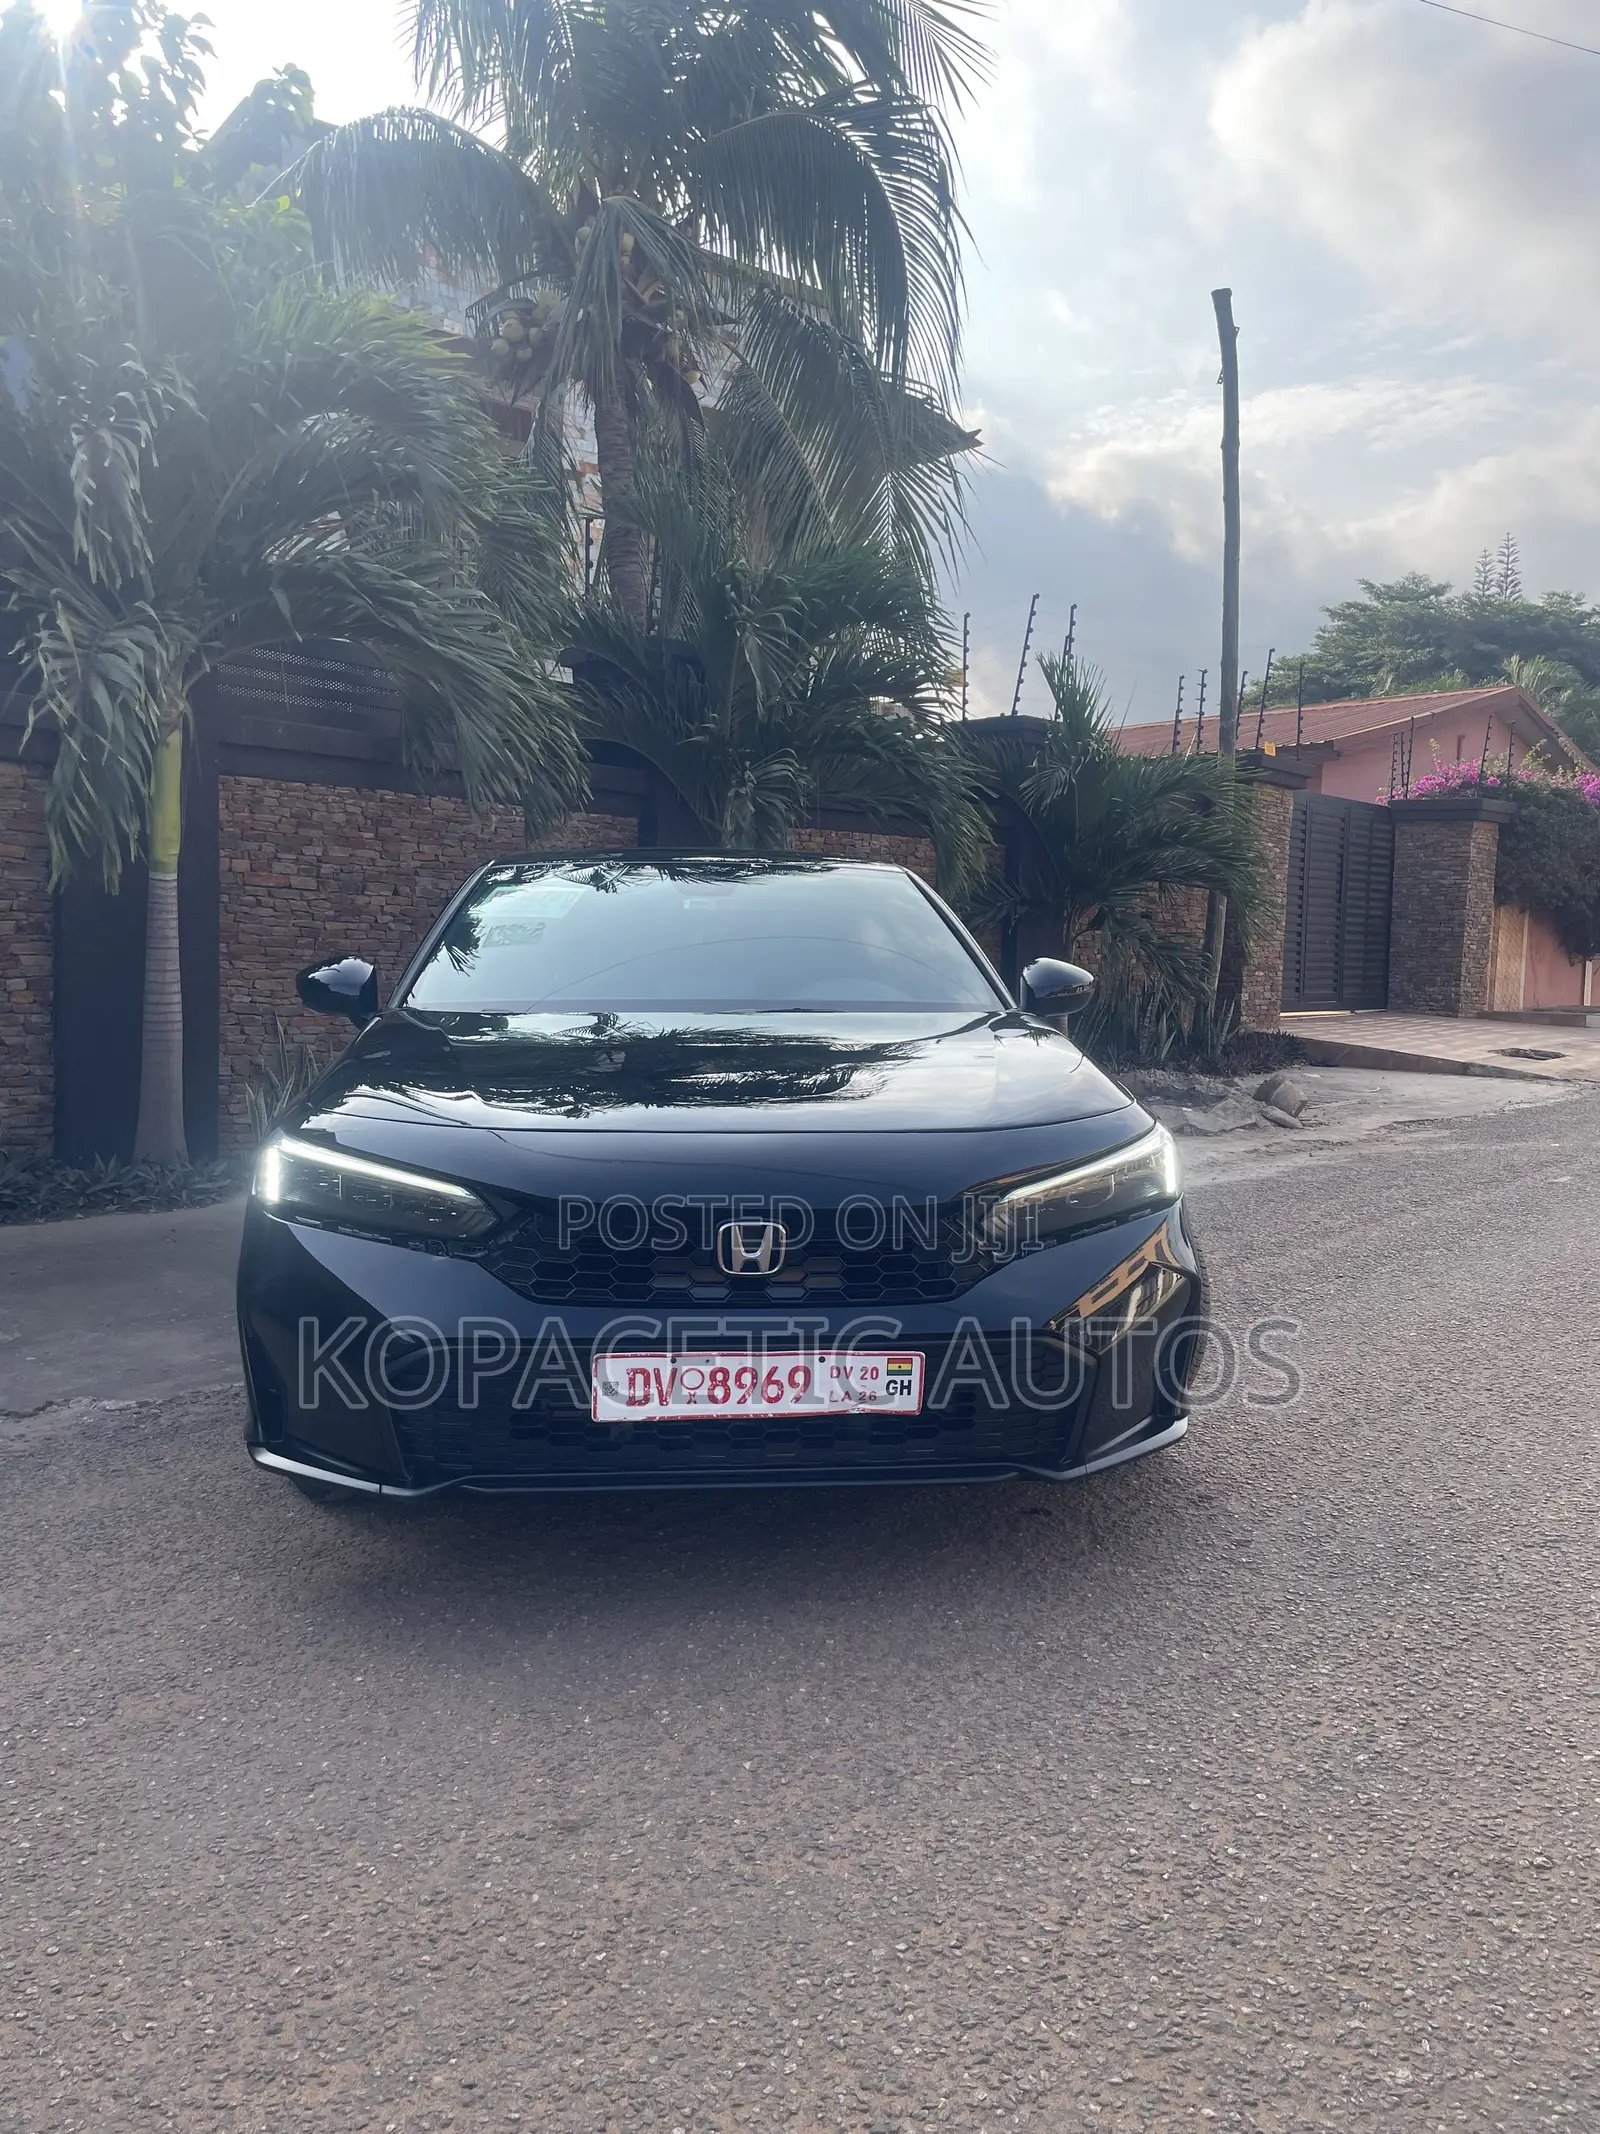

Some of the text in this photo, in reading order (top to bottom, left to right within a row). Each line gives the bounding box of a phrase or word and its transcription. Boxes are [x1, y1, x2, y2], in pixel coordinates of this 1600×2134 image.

[830, 1365, 880, 1380] DV 20
[625, 1365, 812, 1407] DV 8969
[885, 1379, 912, 1396] GH
